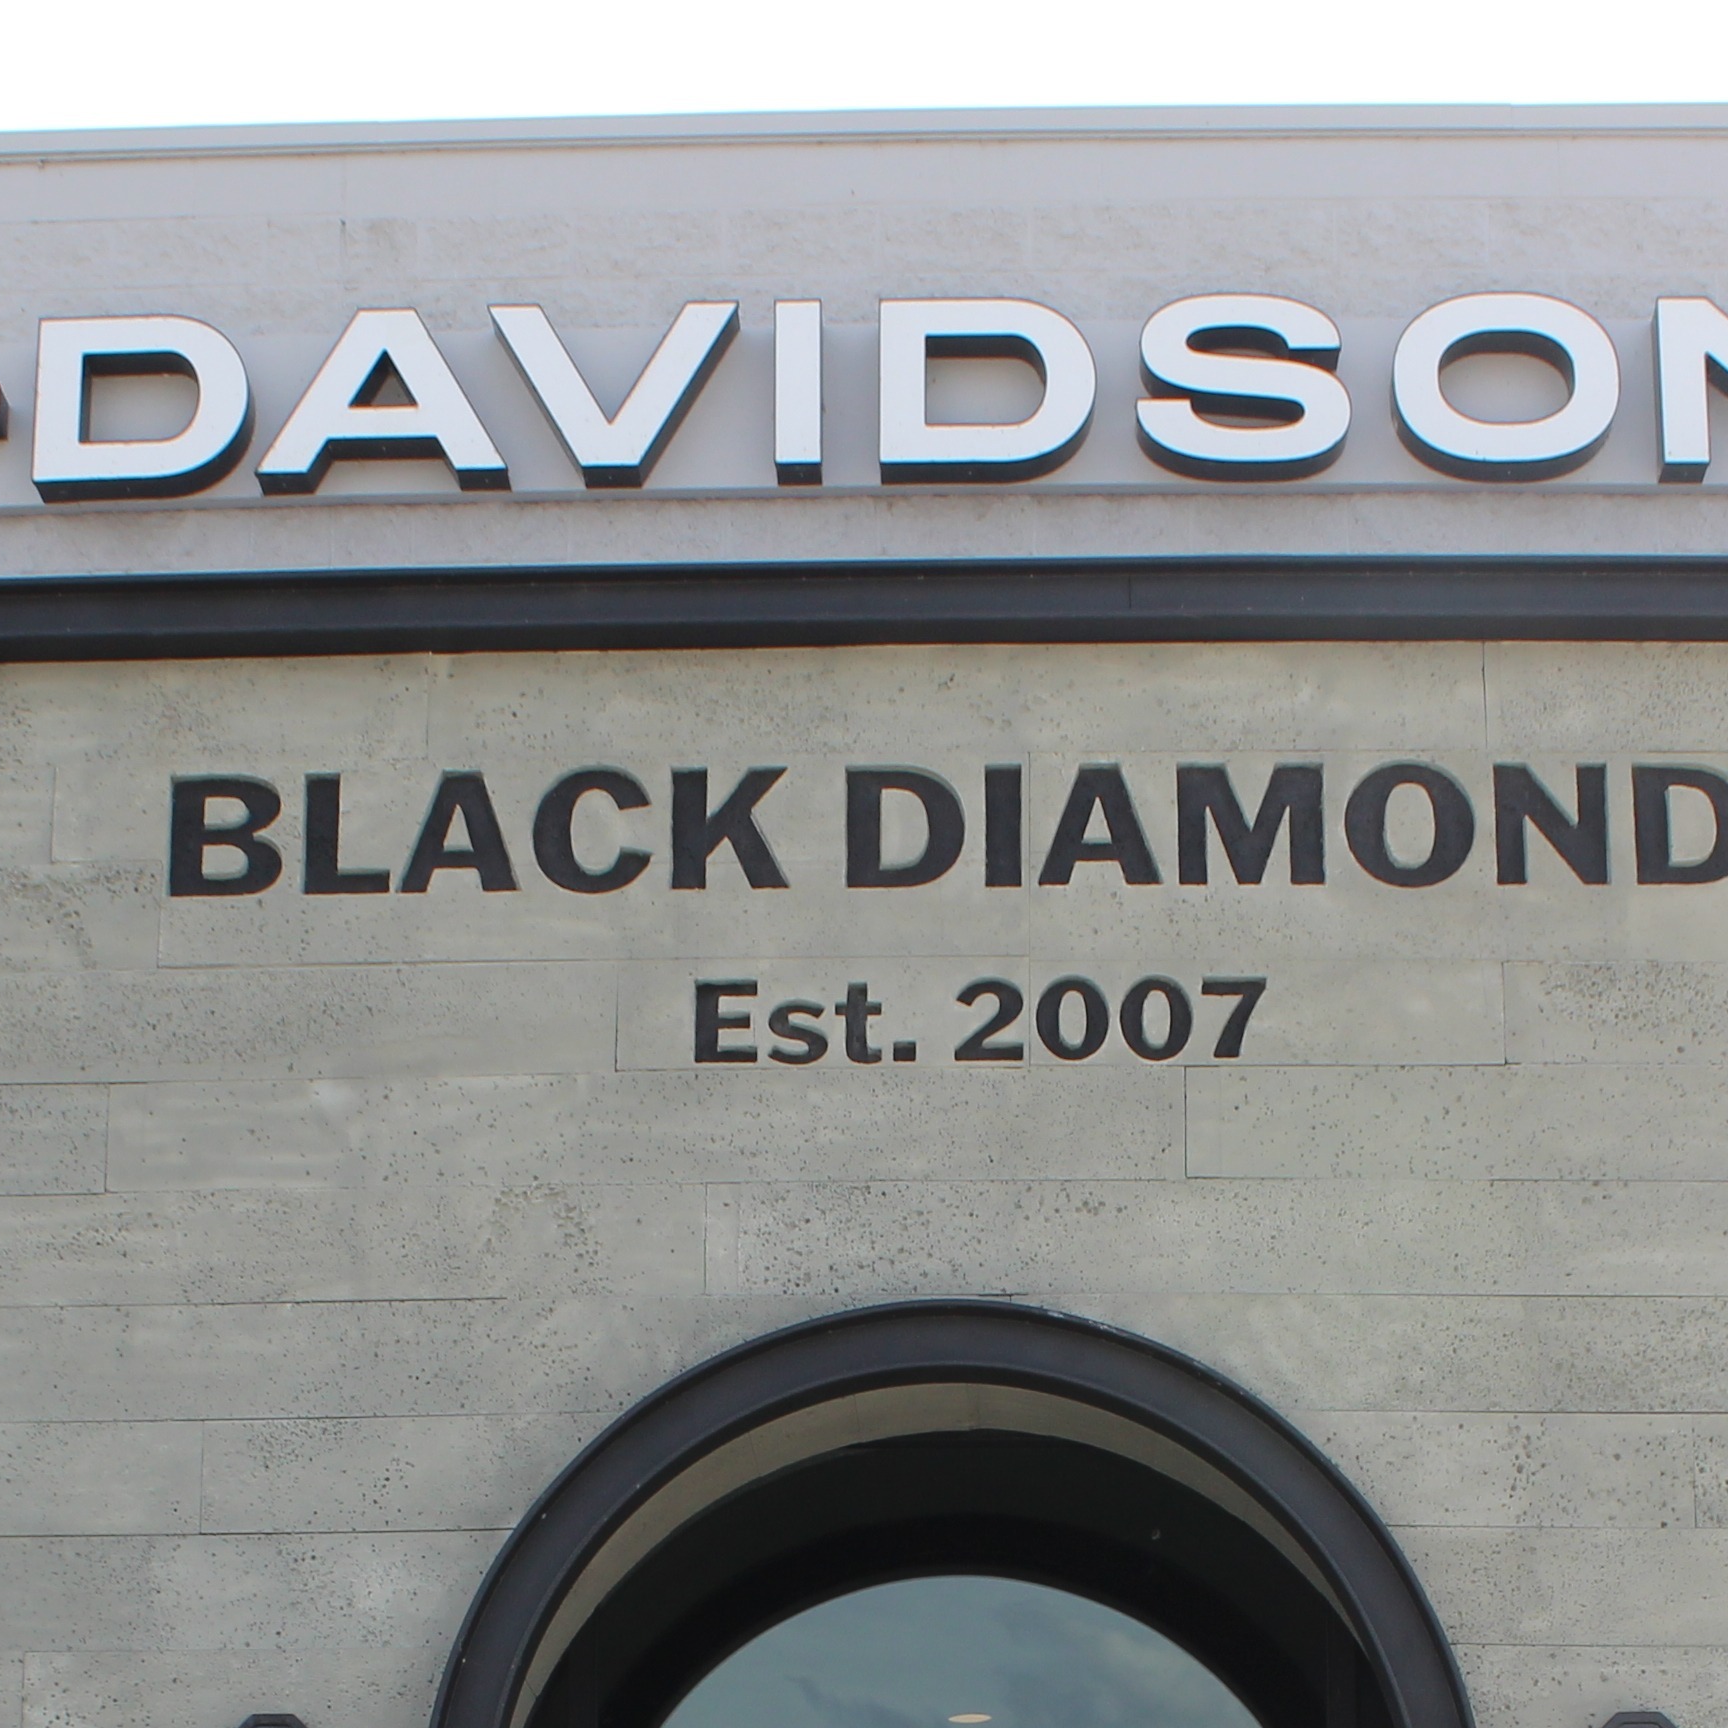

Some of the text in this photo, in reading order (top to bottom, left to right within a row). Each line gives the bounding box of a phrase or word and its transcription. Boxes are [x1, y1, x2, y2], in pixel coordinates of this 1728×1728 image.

[168, 765, 791, 897] BLACK
[694, 975, 1268, 1065] Est. 2007
